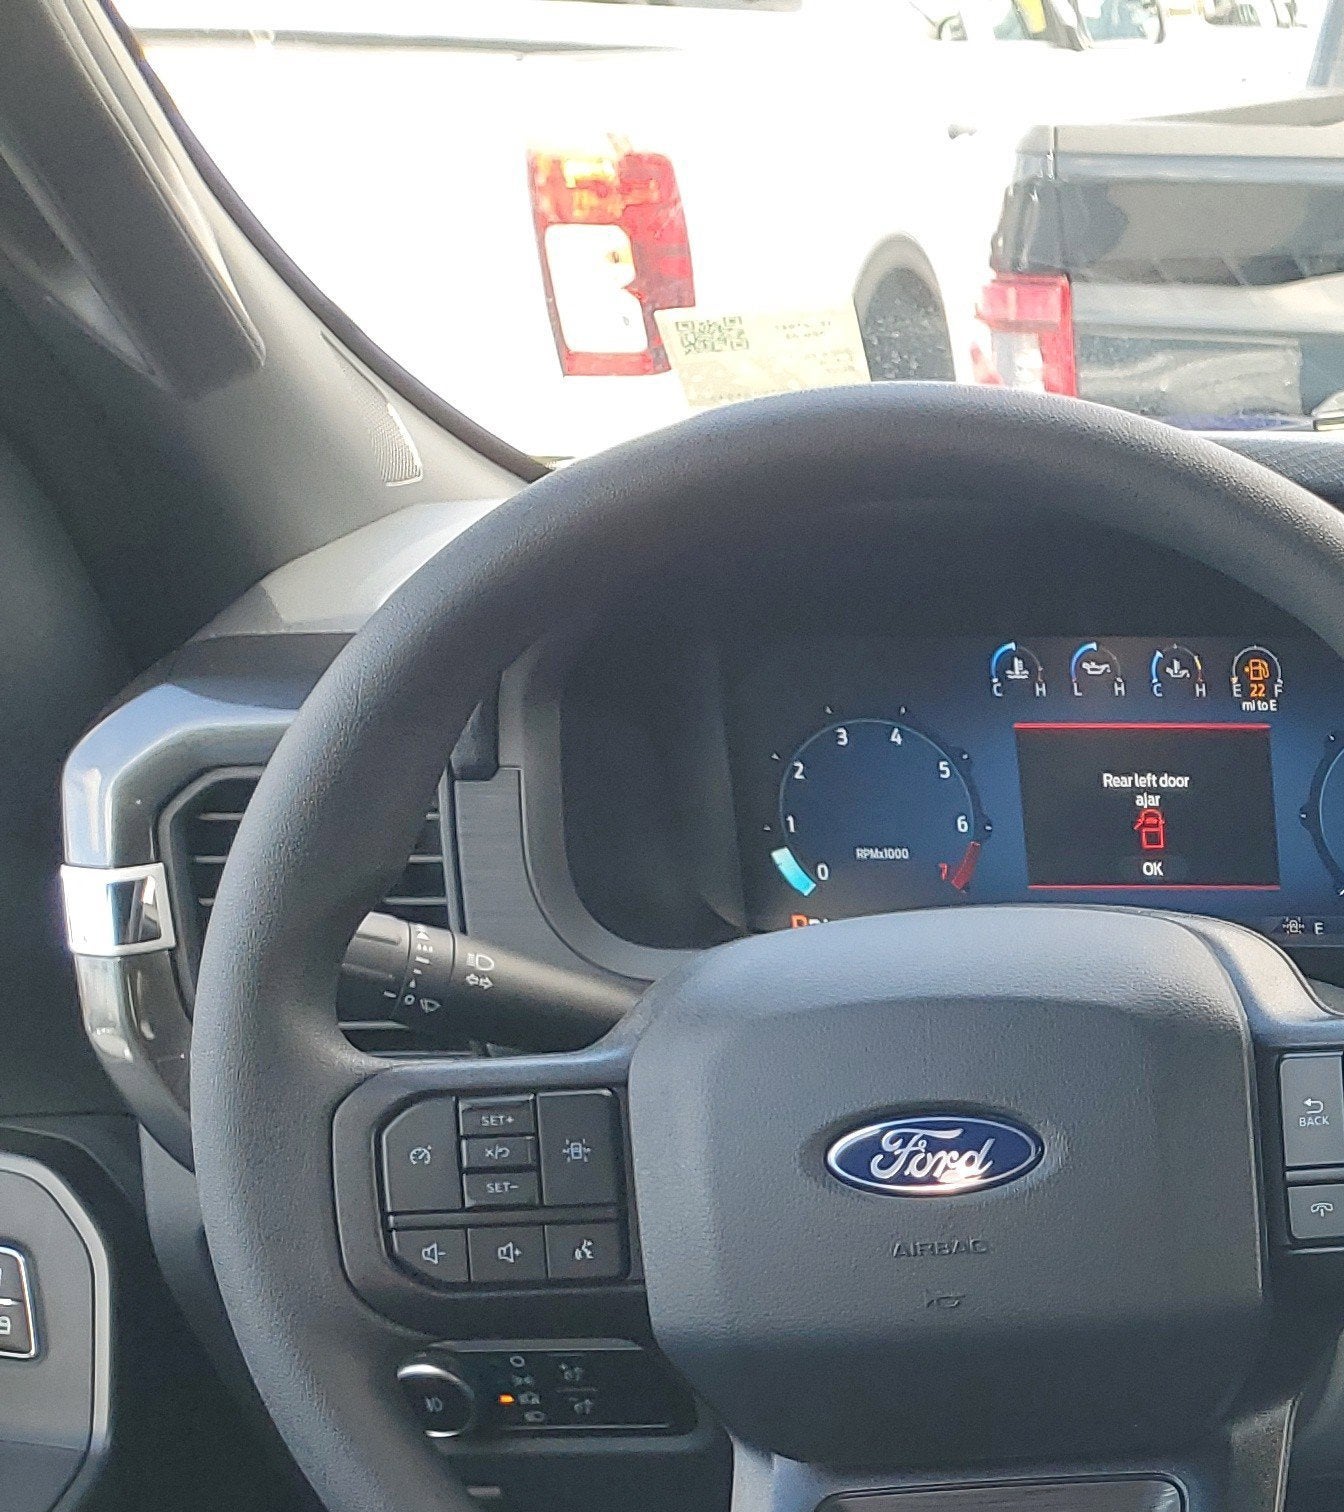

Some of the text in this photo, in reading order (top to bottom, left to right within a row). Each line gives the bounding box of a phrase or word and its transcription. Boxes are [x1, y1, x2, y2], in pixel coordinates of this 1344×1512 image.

[993, 683, 1003, 697] C
[1035, 683, 1046, 697] H
[1073, 683, 1082, 697] L
[1114, 683, 1125, 697] H
[1153, 684, 1163, 697] C
[1195, 684, 1206, 697] H
[1233, 684, 1242, 697] E
[1250, 684, 1266, 697] 22
[1274, 684, 1283, 697] F
[1242, 700, 1277, 711] mi to E
[834, 727, 848, 746] 3
[890, 727, 902, 746] 4
[793, 761, 805, 780] 2
[938, 760, 951, 779] 5
[1103, 772, 1190, 788] Rear left door
[1135, 792, 1161, 808] ajar
[786, 814, 796, 833] 1
[956, 815, 969, 833] 6
[855, 848, 909, 861] RPMx1000
[817, 863, 829, 881] 0
[1142, 862, 1164, 877] OK
[1314, 922, 1324, 935] E
[1299, 1116, 1330, 1127] BACK
[869, 1127, 996, 1182] Ford
[892, 1237, 989, 1259] AIRBAG
